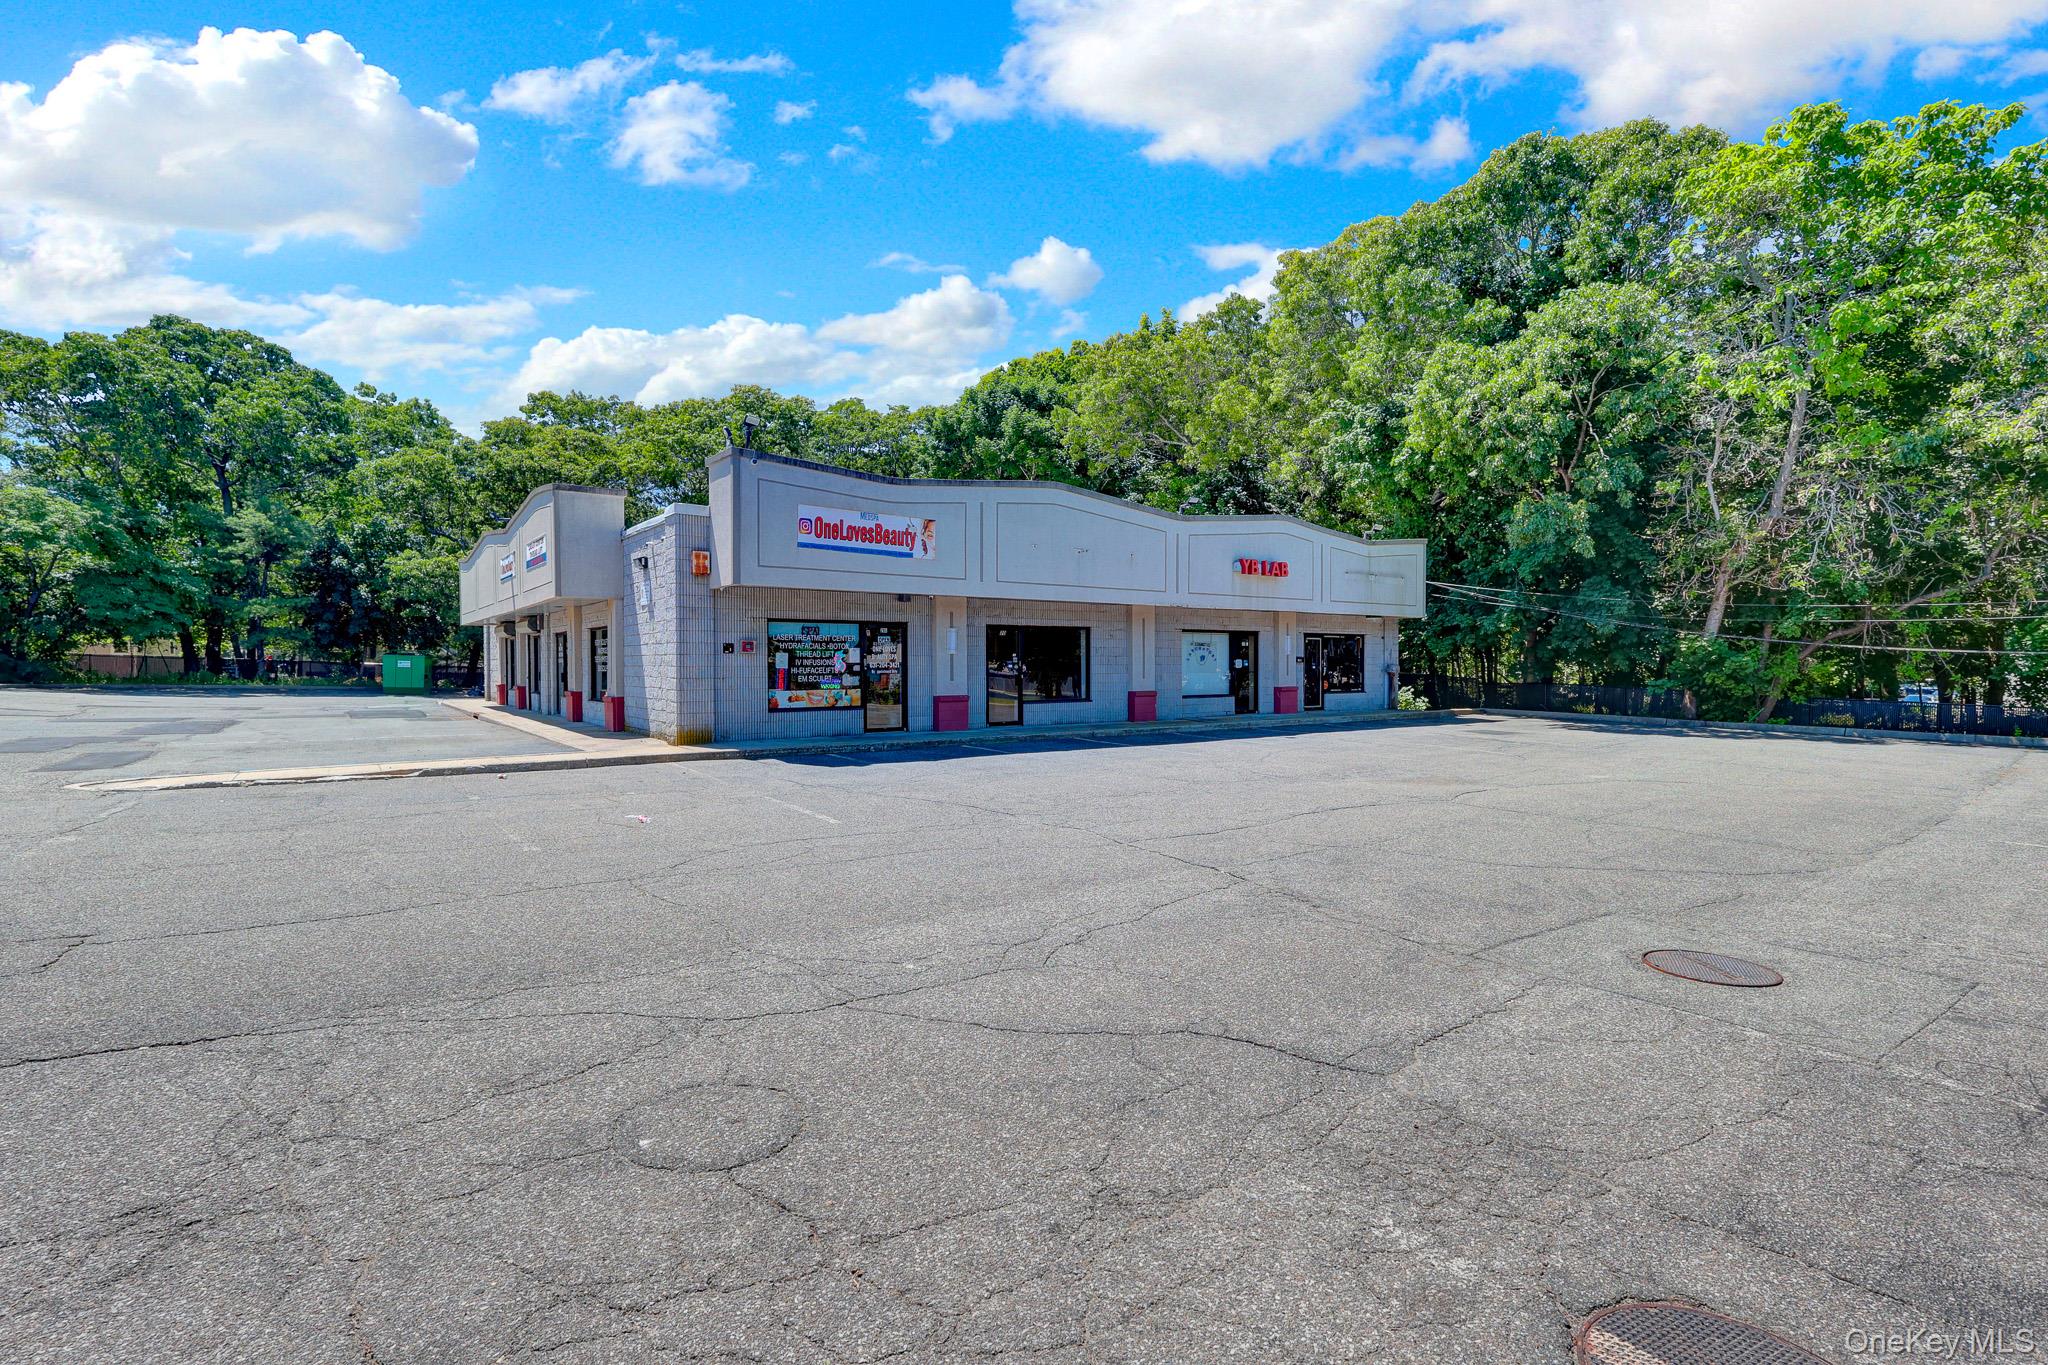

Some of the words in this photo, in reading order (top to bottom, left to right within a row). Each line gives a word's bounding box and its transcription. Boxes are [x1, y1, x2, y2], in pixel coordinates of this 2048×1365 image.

[814, 516, 917, 551] OneLovesBeauty
[1239, 558, 1259, 575] YB
[1261, 560, 1289, 577] LAB
